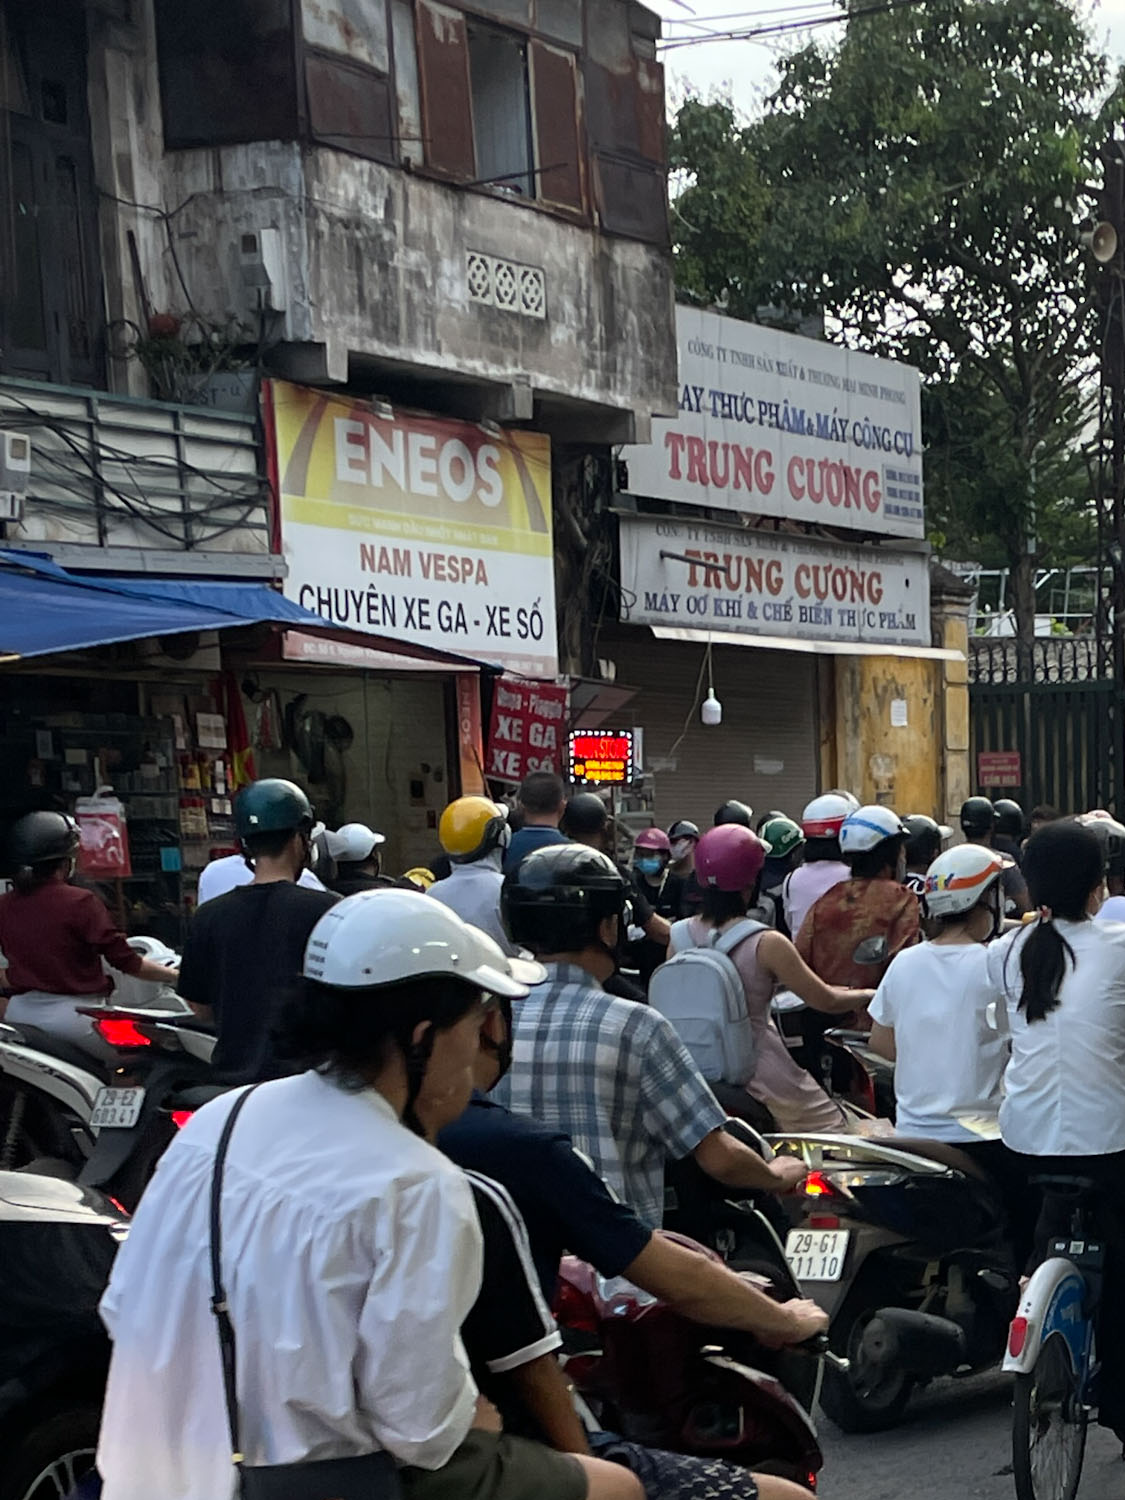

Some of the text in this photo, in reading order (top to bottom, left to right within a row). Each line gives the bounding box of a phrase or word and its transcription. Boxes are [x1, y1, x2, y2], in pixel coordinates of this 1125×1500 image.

[816, 407, 850, 444] MÁY
[852, 417, 892, 452] CÔNG
[333, 416, 504, 508] ENEOS
[665, 431, 775, 495] TRUNG
[360, 543, 489, 586] NAM VESPA
[684, 549, 784, 595] TRUNG
[299, 583, 396, 628] CHUYÊN
[402, 596, 431, 631] XE
[438, 600, 468, 635] GA
[486, 605, 512, 638] XE
[516, 597, 544, 642] SỐ
[644, 586, 681, 613] MÁY
[495, 714, 523, 743] XE
[529, 720, 557, 749] GA
[491, 748, 521, 778] XE
[793, 1233, 838, 1254] 29-G1
